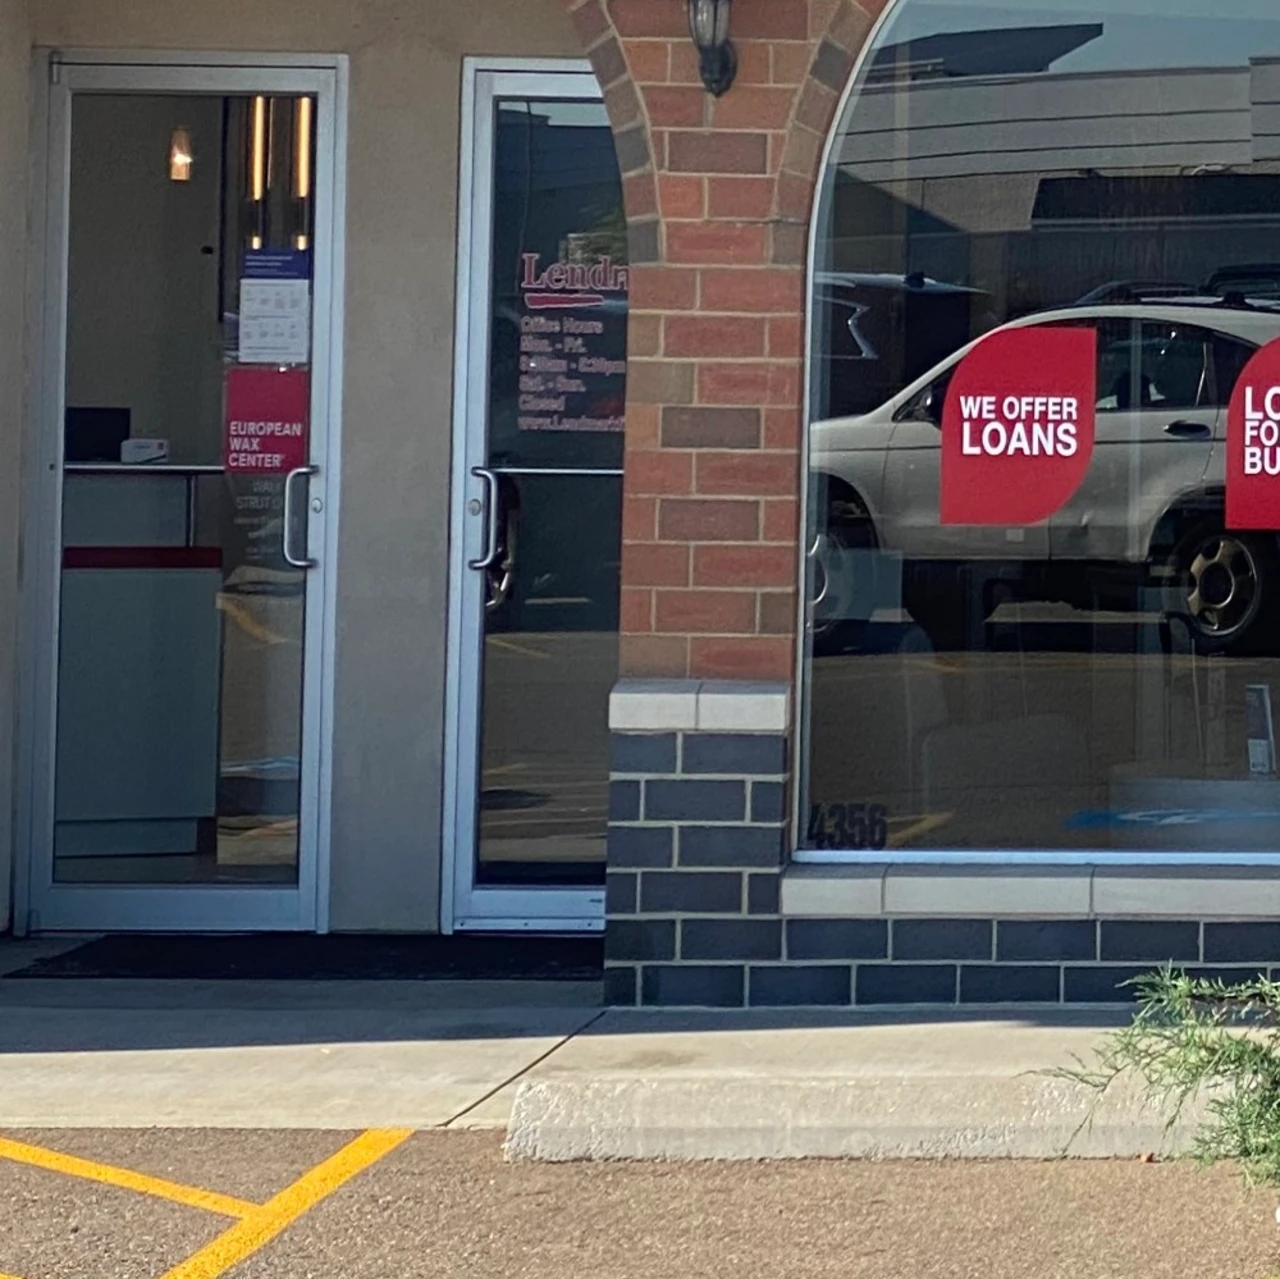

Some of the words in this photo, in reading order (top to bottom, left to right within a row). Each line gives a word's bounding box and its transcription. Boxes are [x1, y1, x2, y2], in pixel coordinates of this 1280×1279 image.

[960, 396, 995, 420] WE
[1002, 396, 1078, 421] OFFER
[229, 422, 302, 436] EUROPEAN
[229, 437, 260, 451] WAX
[962, 422, 1078, 457] LOANS
[228, 453, 281, 467] CENTER
[808, 803, 888, 849] 4356
